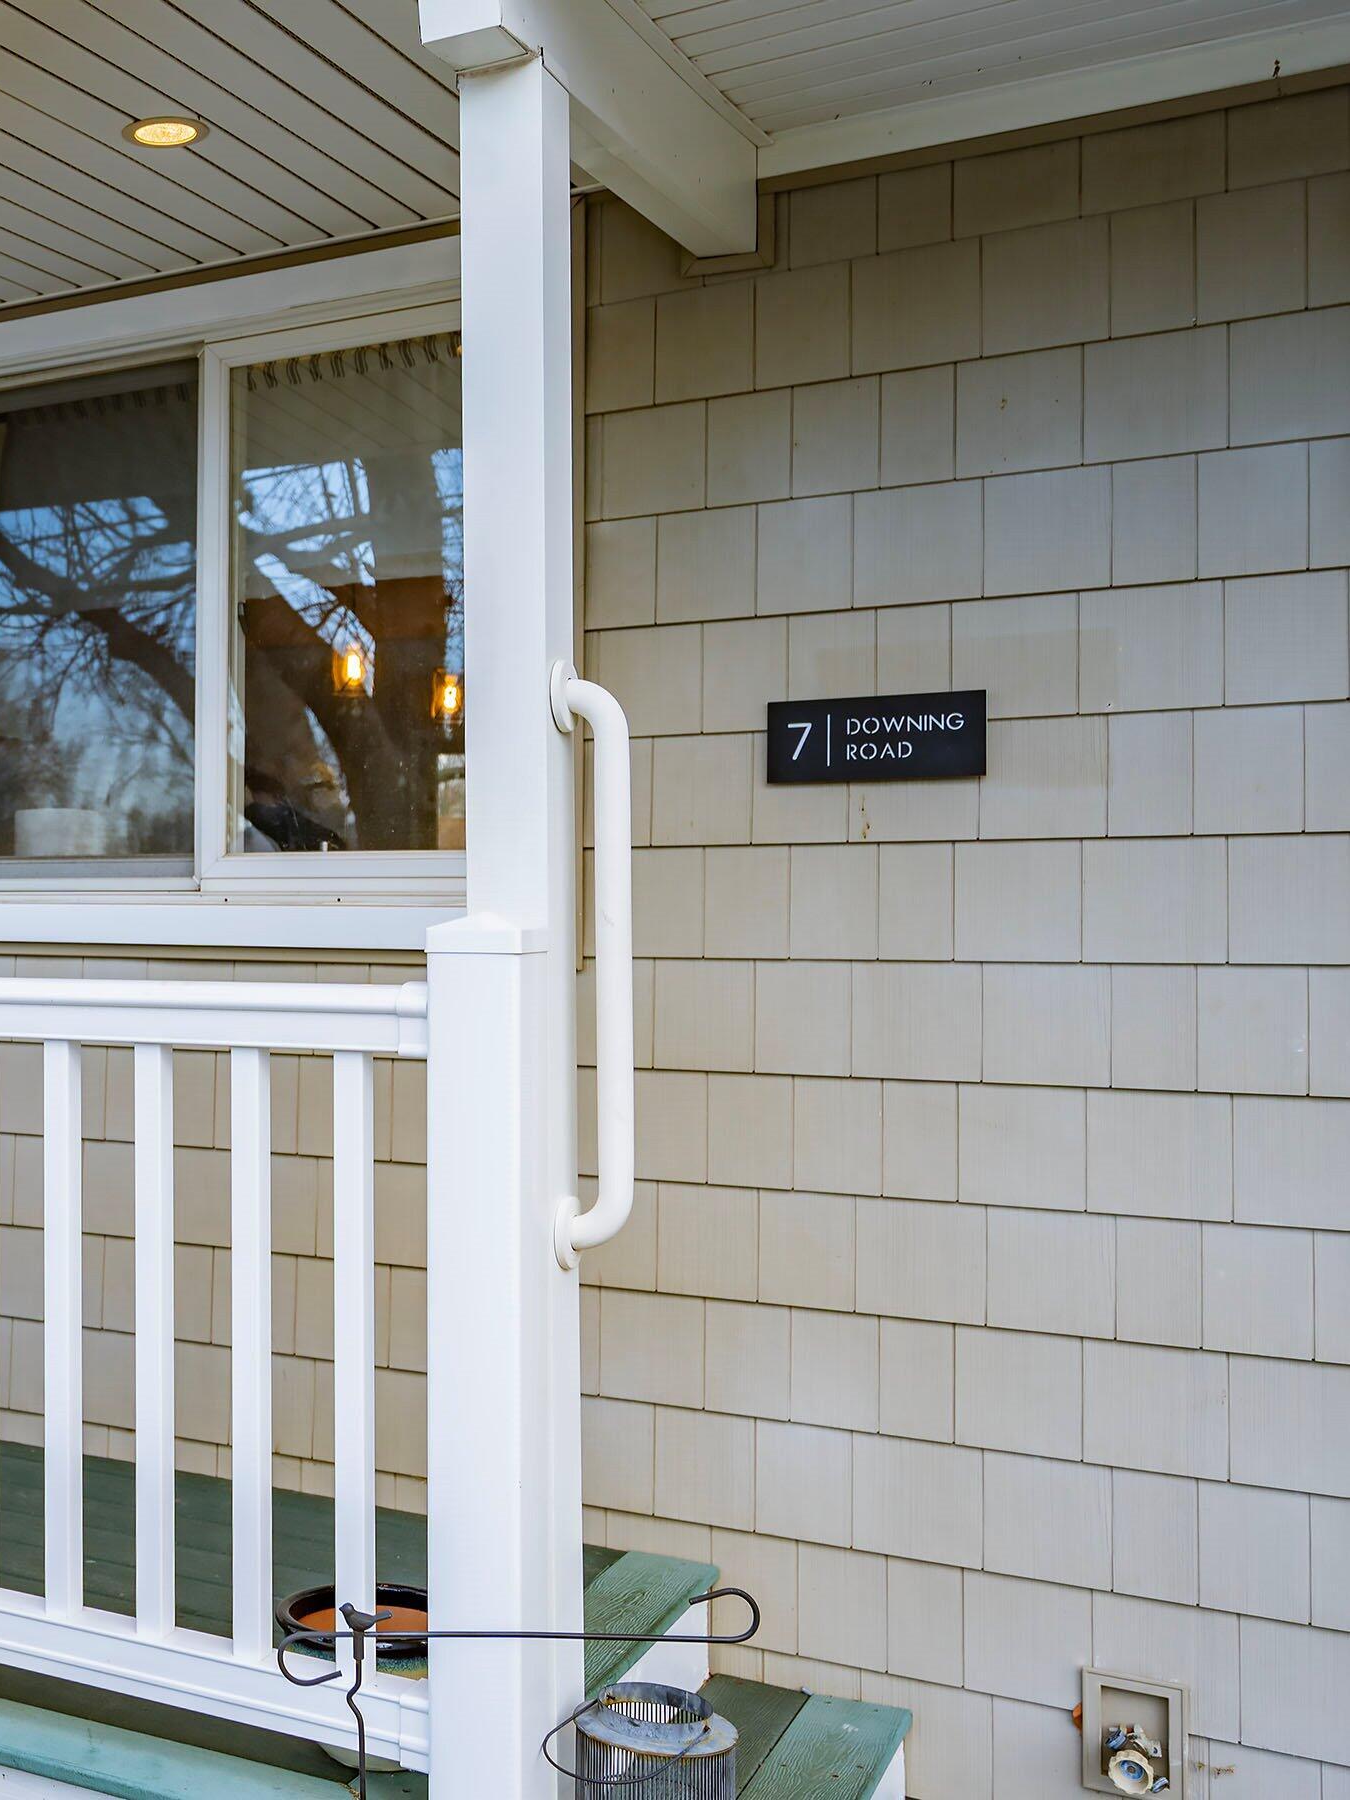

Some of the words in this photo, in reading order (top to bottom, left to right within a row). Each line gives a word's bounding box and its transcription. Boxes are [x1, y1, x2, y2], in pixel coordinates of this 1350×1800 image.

[846, 713, 965, 735] DOWNING
[787, 722, 813, 761] 7
[846, 742, 913, 760] ROAD
